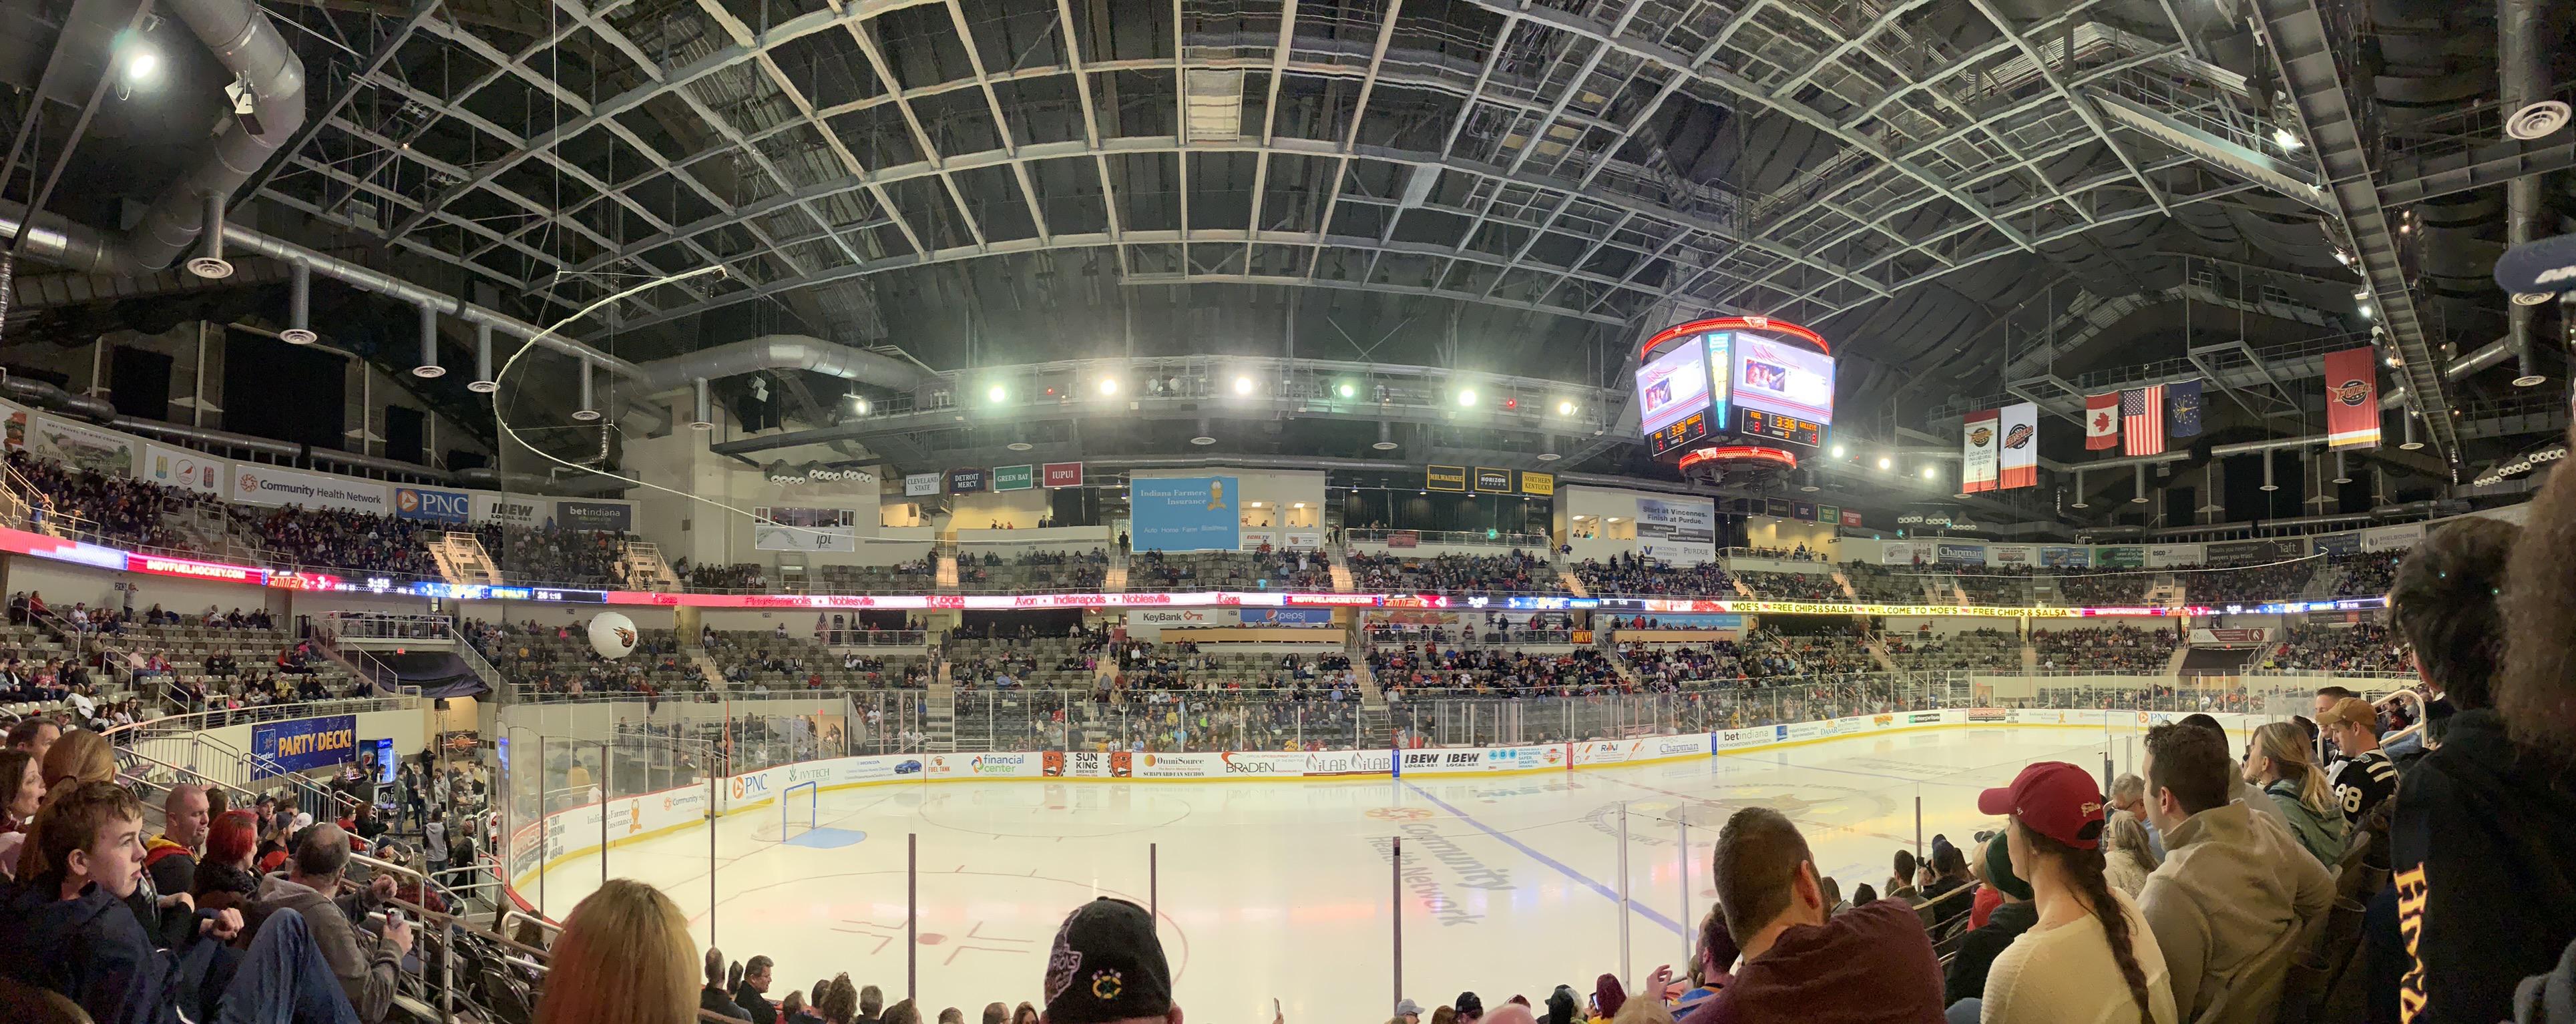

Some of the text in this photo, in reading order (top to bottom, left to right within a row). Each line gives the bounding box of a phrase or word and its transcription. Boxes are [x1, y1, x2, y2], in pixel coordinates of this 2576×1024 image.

[955, 473, 979, 482] DETROIT
[998, 475, 1016, 483] GREEN
[1052, 471, 1074, 479] IUPUI
[1430, 473, 1463, 482] MILWAUKEE
[1524, 475, 1551, 484] NORTHERN
[907, 477, 938, 485] CLEVELAND
[957, 481, 977, 489] MERCY
[260, 479, 381, 505] Community Health Network
[1525, 483, 1551, 491] KENTUCKY
[421, 493, 469, 515] PNC
[491, 503, 533, 517] IBEW
[570, 507, 620, 517] betindiana
[1671, 509, 1707, 517] Vincennes.
[816, 532, 832, 549] ipi
[1683, 547, 1709, 555] PURDUE
[1939, 547, 1983, 559] Chapman
[2280, 543, 2296, 553] Taft
[147, 559, 246, 579] INDYFUELHOCKEY.COM
[317, 576, 326, 589] 3
[367, 577, 390, 589] 3:55
[426, 584, 433, 595] 3
[829, 596, 875, 606] Noblesville
[1015, 596, 1038, 606] Avon
[1054, 595, 1106, 605] Indianapolis
[1122, 594, 1170, 604] Noblesville
[1292, 596, 1372, 604] INDYFUELHOCKEY.COM
[1732, 603, 1793, 611] MOE'S FREE
[1914, 606, 1926, 614] TO
[1930, 606, 1958, 615] MOE'S
[1973, 608, 1996, 616] FREE
[1998, 609, 2025, 617] CHIPS
[2027, 609, 2033, 617] &
[2035, 609, 2067, 617] SALSA
[1143, 613, 1182, 621] KeyBank
[1279, 611, 1306, 621] pepsi
[1573, 631, 1592, 643] HKY!
[1910, 714, 1940, 722] enterprise
[2150, 713, 2172, 722] PNC
[1724, 730, 1769, 741] betindiana
[278, 729, 352, 758] PARTY DECK!
[1660, 743, 1699, 754] Chapman
[984, 754, 1024, 764] financial
[1076, 752, 1098, 762] SUN
[1405, 754, 1440, 764] IBEW
[1446, 752, 1480, 762] IBEW
[984, 764, 1016, 773] center
[1076, 762, 1098, 770] KING
[1226, 762, 1275, 773] BRADEN
[1319, 759, 1347, 772] iLAB
[1363, 758, 1390, 770] iLAB
[745, 774, 768, 794] PNC
[672, 795, 698, 806] Community
[1400, 822, 1517, 891] Community
[1401, 866, 1486, 927] Network
